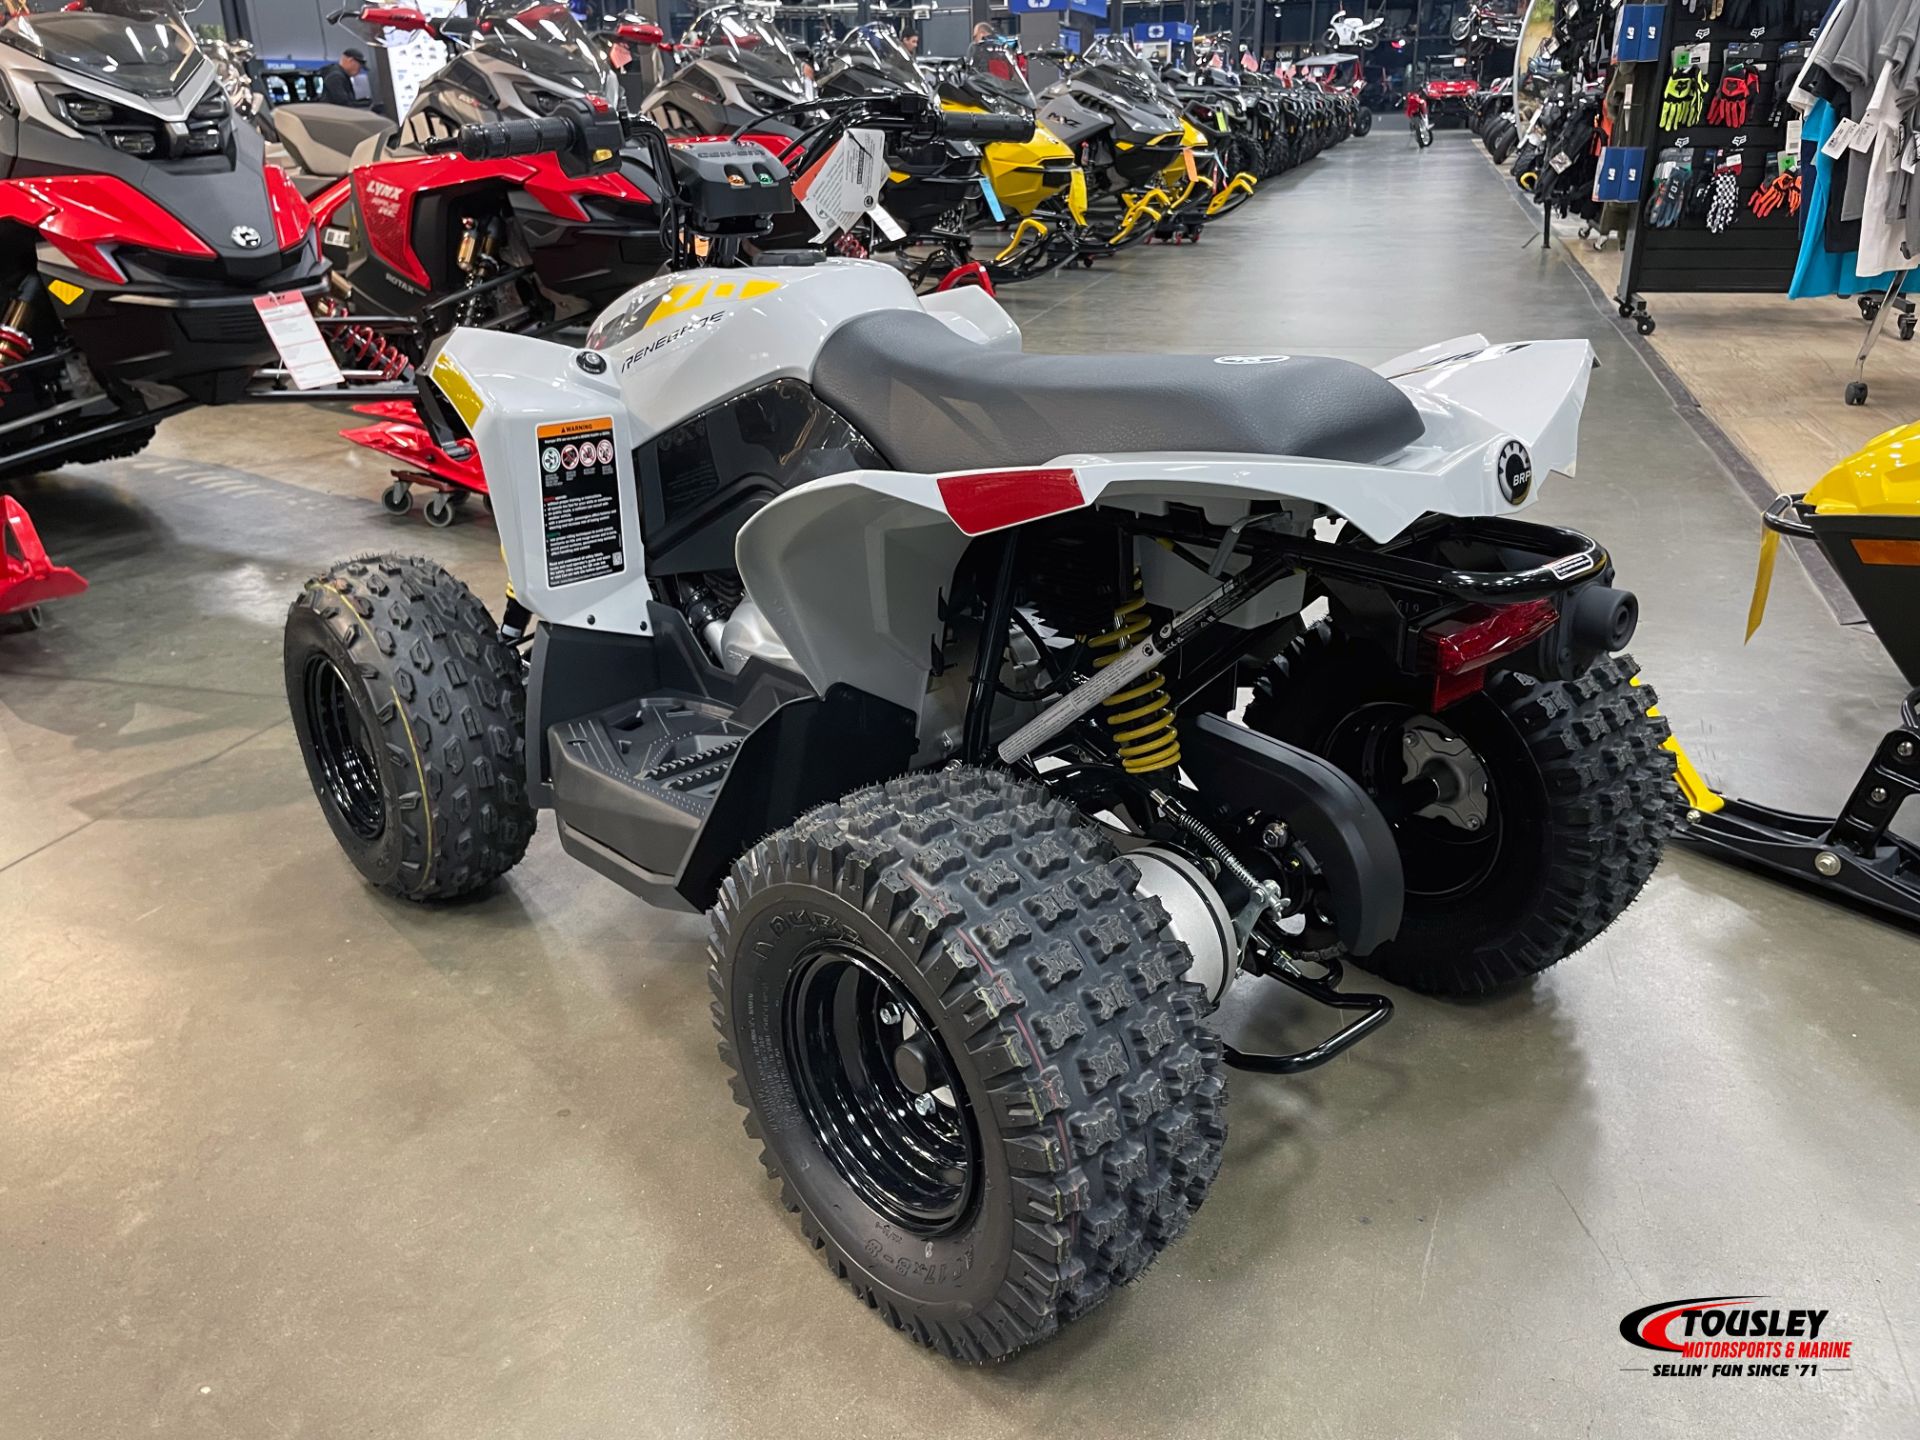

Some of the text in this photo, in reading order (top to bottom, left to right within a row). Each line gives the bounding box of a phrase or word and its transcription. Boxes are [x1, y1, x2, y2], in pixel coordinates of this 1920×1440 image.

[366, 180, 404, 201] LYNX
[1668, 180, 1679, 200] FOX
[566, 424, 593, 432] WARNING
[1512, 469, 1531, 487] BRP
